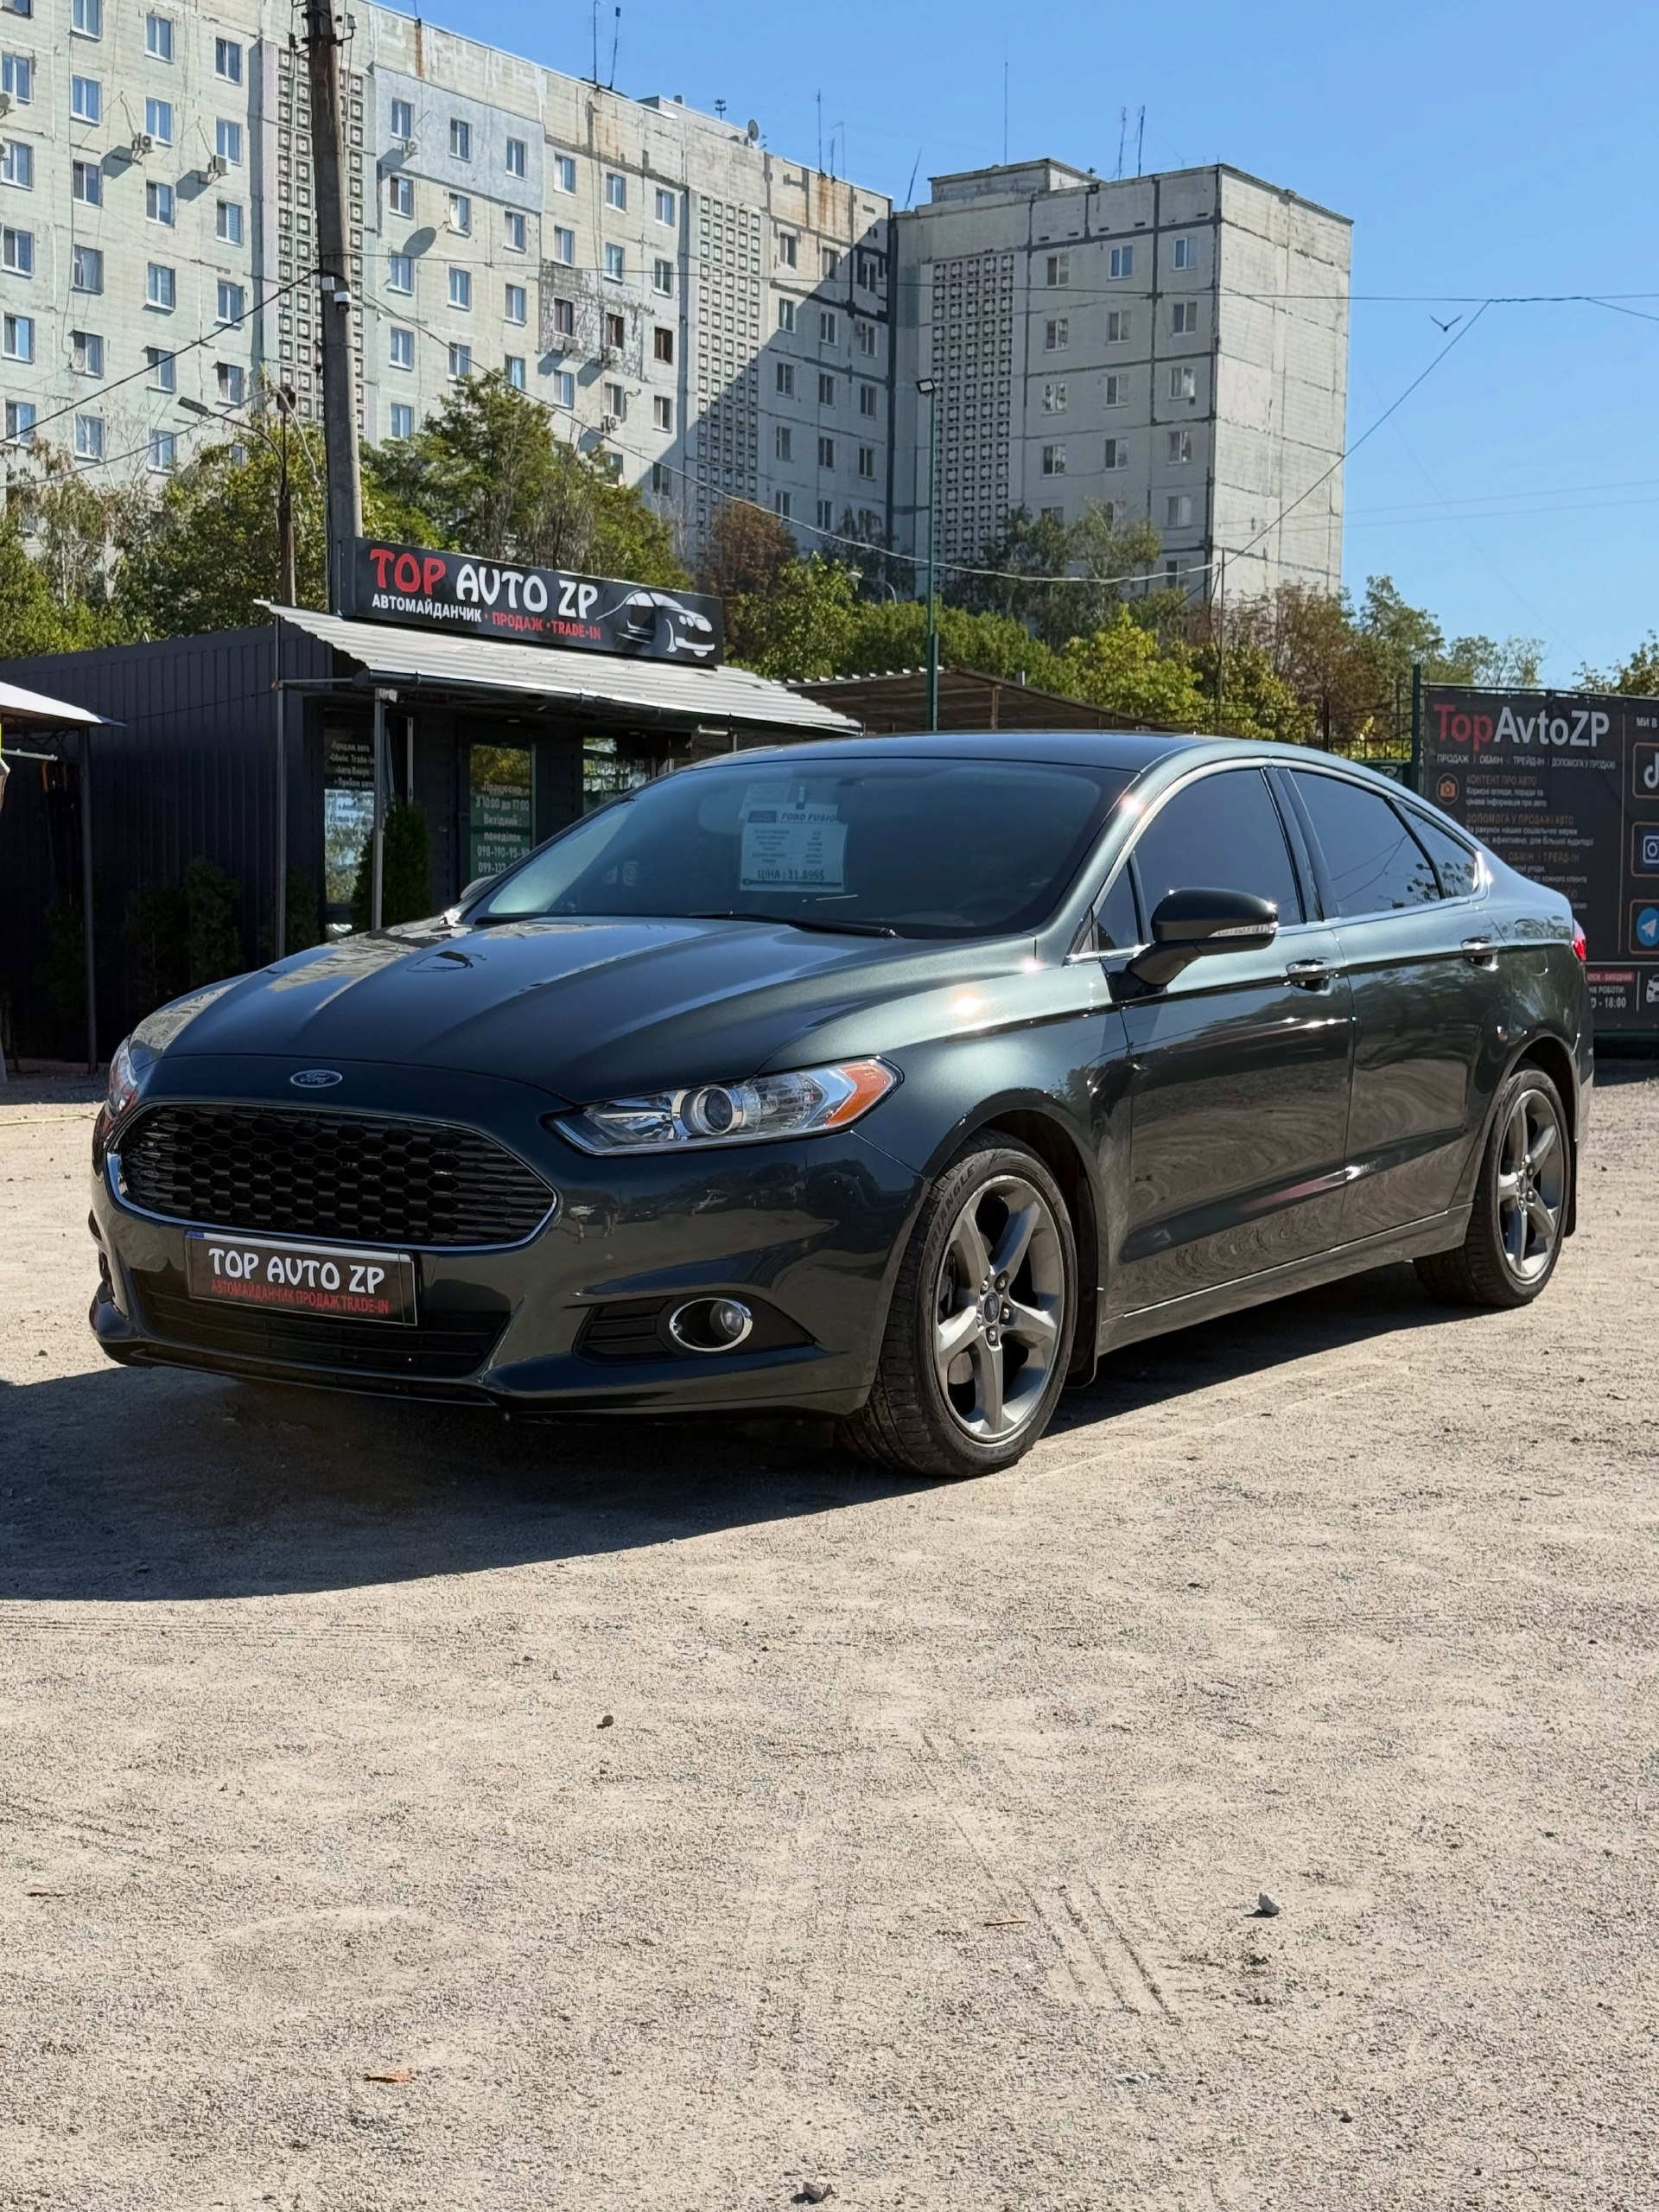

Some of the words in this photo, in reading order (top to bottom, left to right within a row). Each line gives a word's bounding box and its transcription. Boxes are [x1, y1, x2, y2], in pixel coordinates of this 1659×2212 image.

[370, 549, 446, 594] TOP
[455, 563, 549, 613] AVTO
[557, 580, 598, 620] ZP
[372, 594, 481, 623] АВТОМАЙДАНЧИК
[493, 612, 543, 632] ПРОДАЖ
[551, 620, 601, 640] TRADE-IN
[1433, 704, 1610, 752] TopAvtoZP
[1437, 753, 1469, 765] ПРОДАЖ
[1479, 755, 1503, 766] ОБМІН
[808, 813, 837, 823] FUSIO
[208, 1248, 259, 1280] TOP
[267, 1255, 340, 1291] AVTO
[348, 1264, 385, 1294] ZP
[211, 1279, 295, 1303] АВТОМАЙДАНЧИК
[296, 1291, 340, 1310] ПРОДАЖ
[342, 1296, 389, 1314] TRADE-IN
